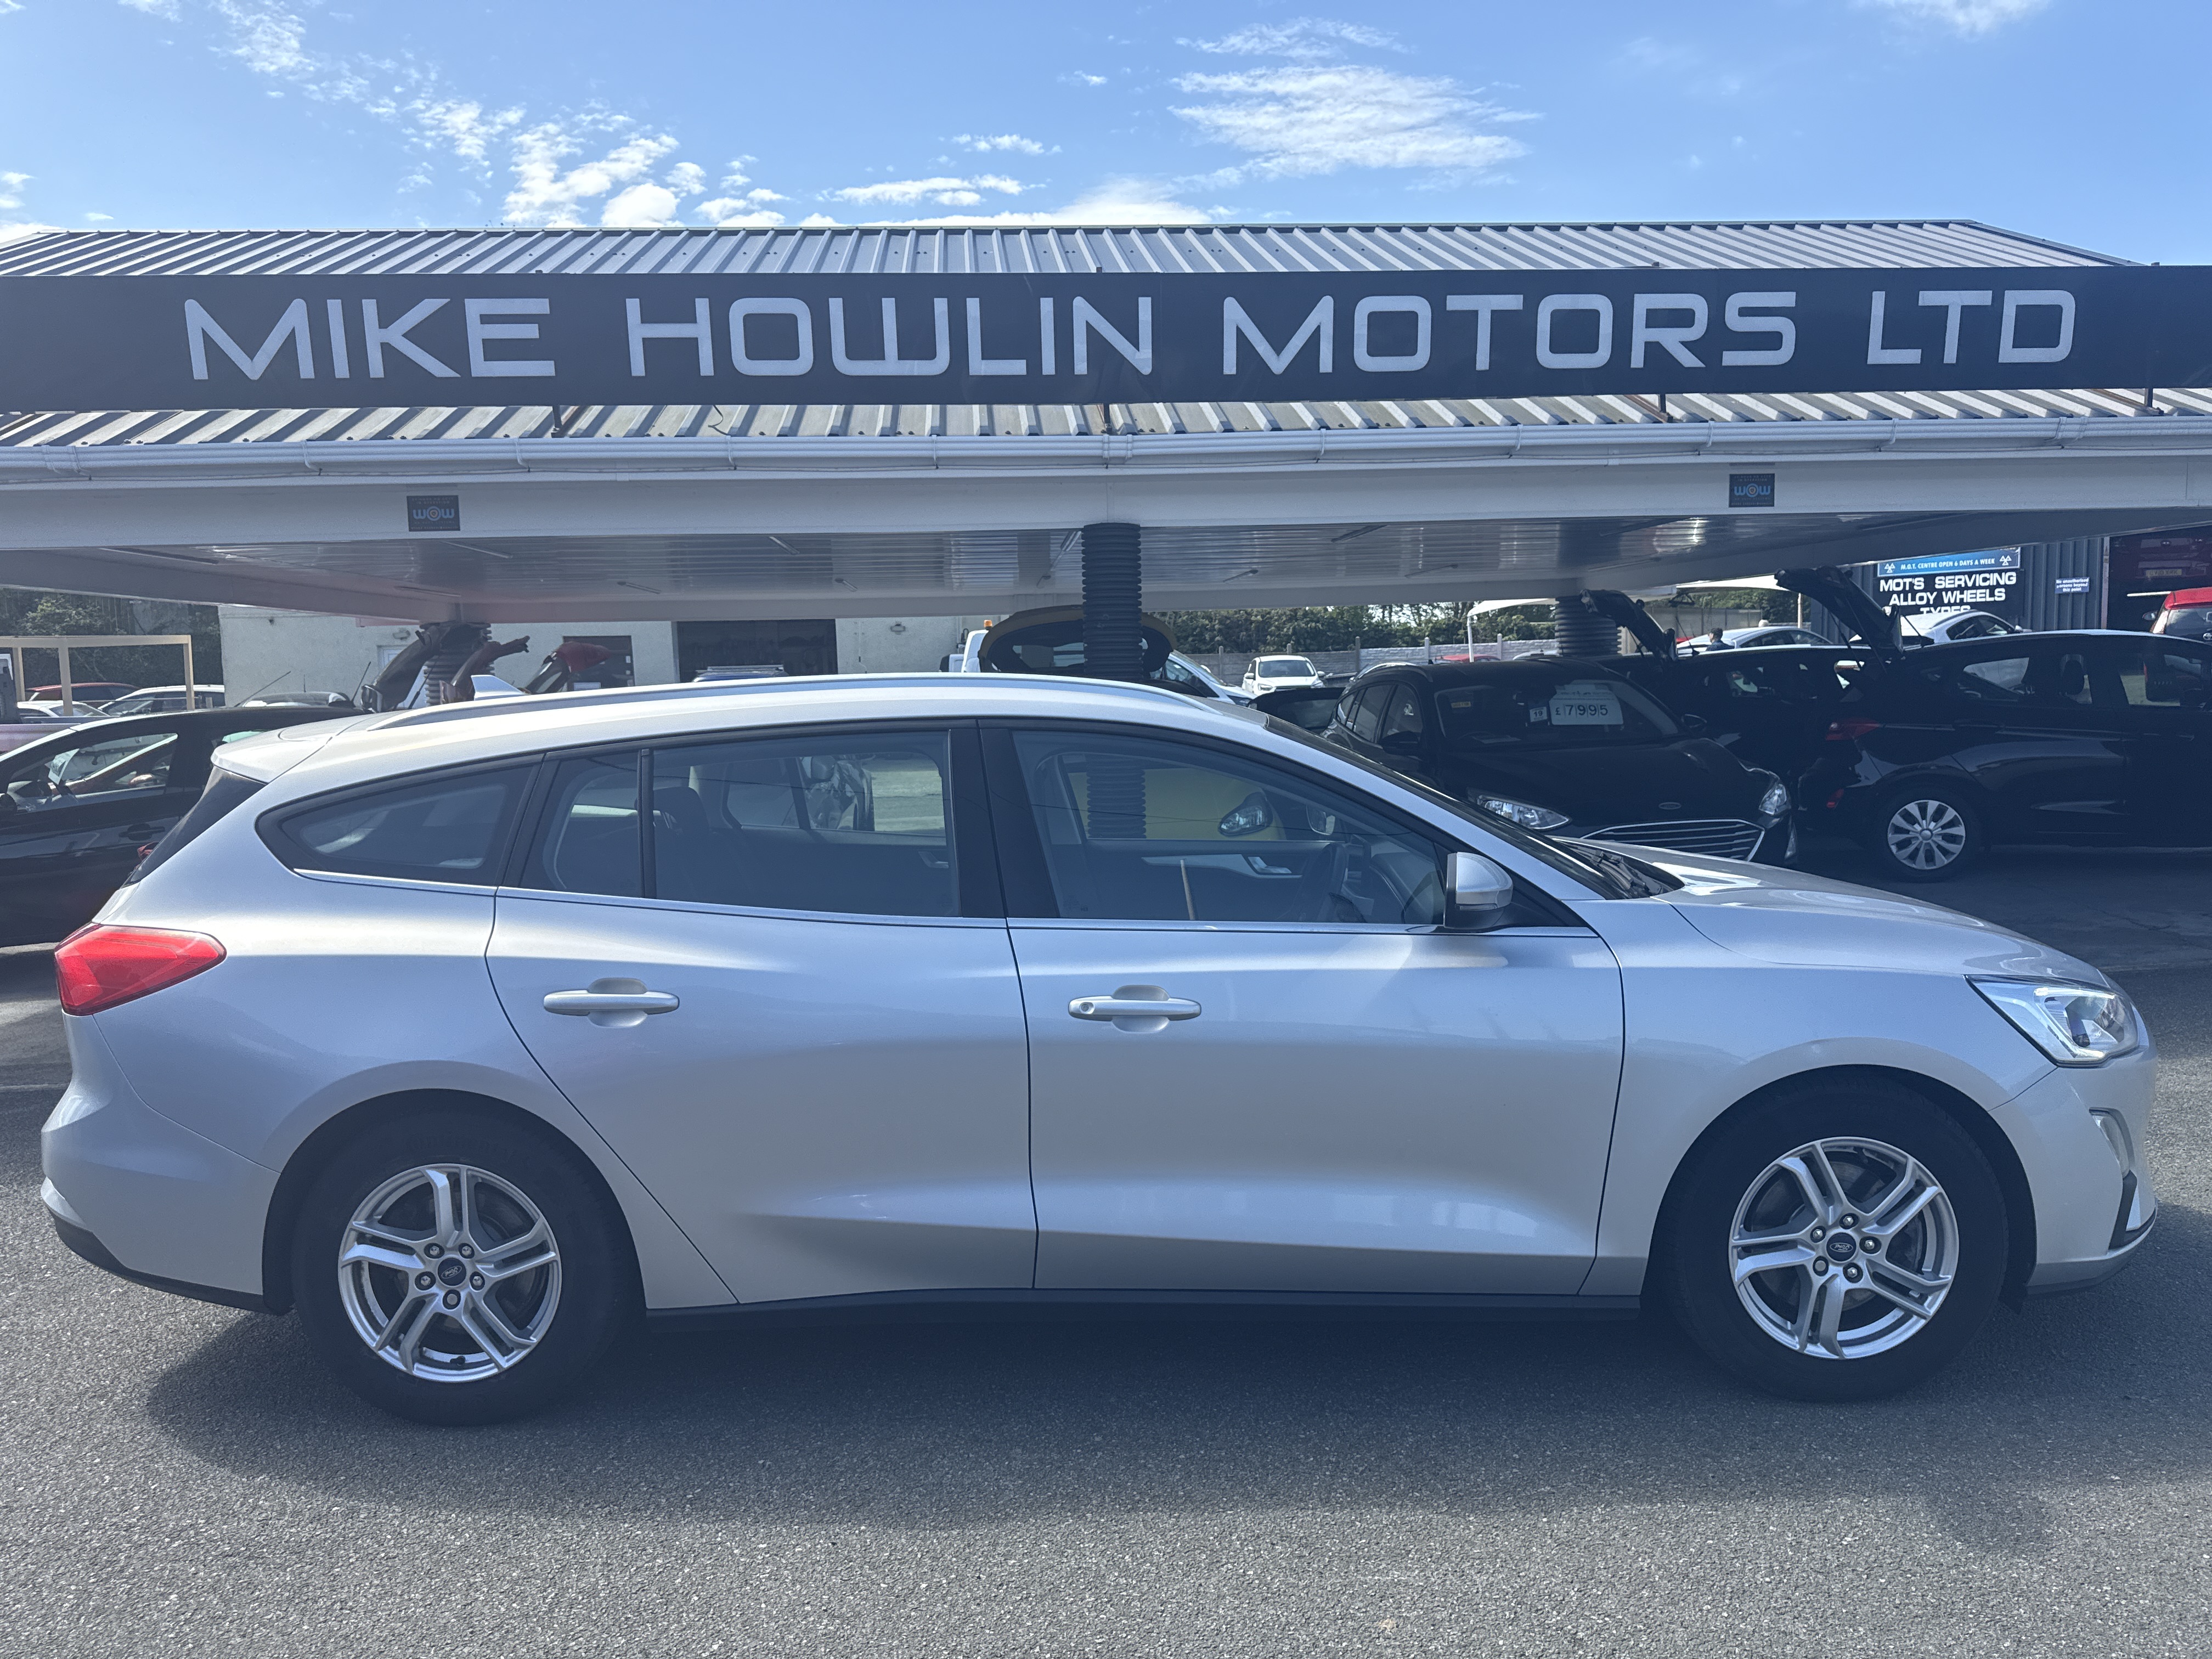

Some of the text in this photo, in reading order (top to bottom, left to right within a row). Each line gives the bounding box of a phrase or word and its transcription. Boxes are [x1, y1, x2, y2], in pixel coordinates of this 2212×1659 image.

[185, 290, 2076, 380] MIKE HOWLIN MOTORS LTD
[1880, 571, 2017, 592] MOT'S SERVICING
[1889, 588, 2006, 606] ALLOY WHEELS
